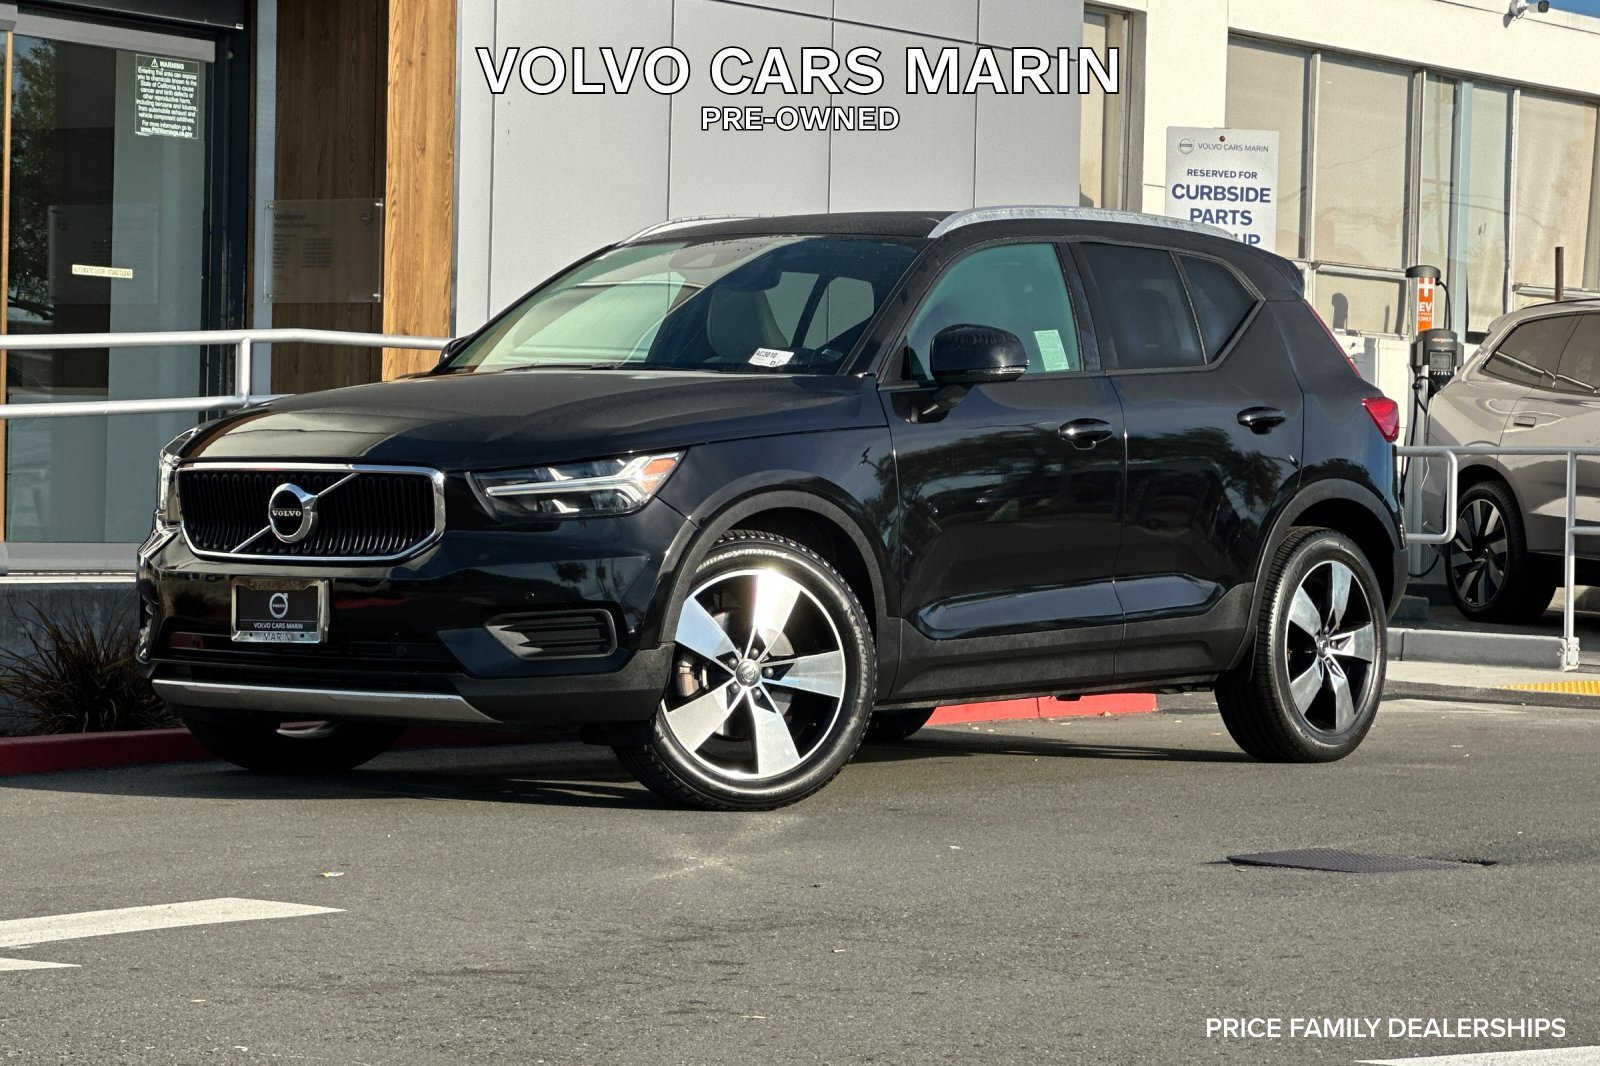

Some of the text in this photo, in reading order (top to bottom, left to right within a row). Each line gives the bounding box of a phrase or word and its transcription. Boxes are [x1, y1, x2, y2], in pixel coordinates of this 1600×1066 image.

[160, 61, 184, 70] WARNING
[1198, 142, 1222, 151] VOLVO
[1223, 144, 1243, 152] CARS
[1187, 168, 1258, 179] RESERVED FOR
[1172, 183, 1271, 203] CURBSIDE
[1190, 208, 1253, 226] PARTS
[1419, 302, 1432, 311] EV
[853, 626, 868, 698] MICHELIN
